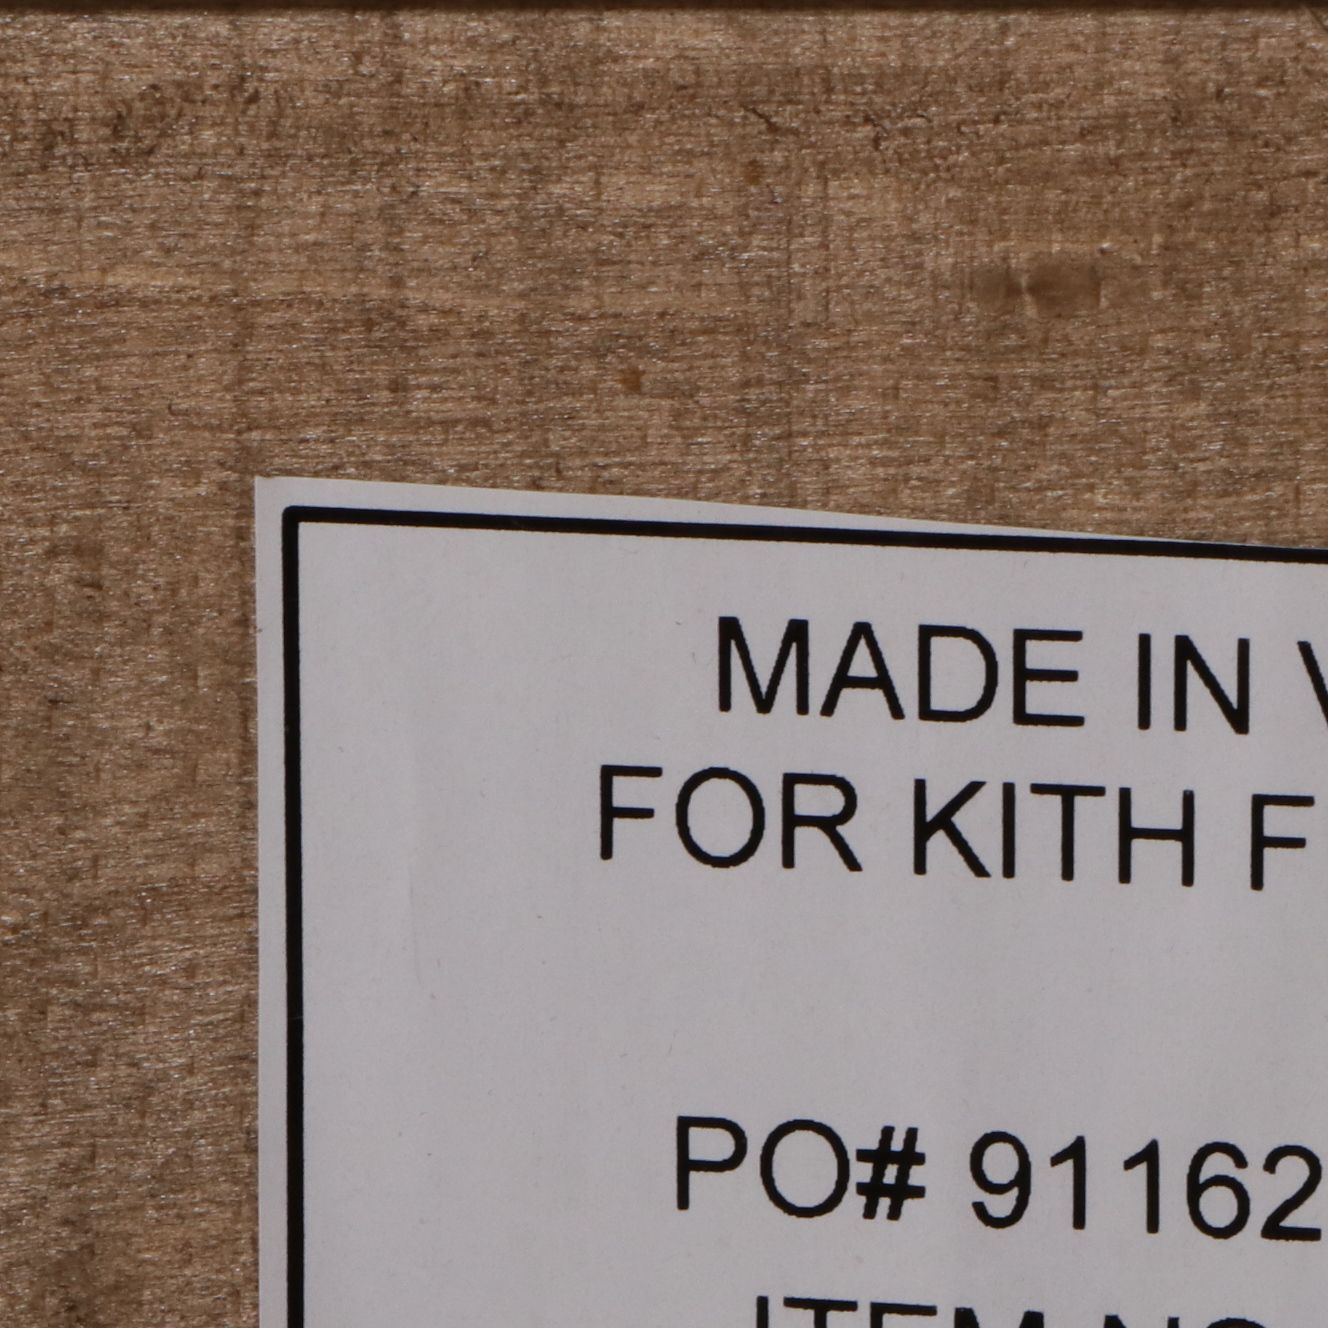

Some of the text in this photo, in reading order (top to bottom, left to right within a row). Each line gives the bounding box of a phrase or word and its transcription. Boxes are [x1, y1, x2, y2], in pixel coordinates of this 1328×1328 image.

[717, 615, 1086, 729] MADE
[1136, 631, 1251, 737] IN
[598, 763, 864, 873] FOR
[912, 777, 1197, 889] KITH
[674, 1114, 927, 1223] PO#
[968, 1129, 1324, 1243] 91162
